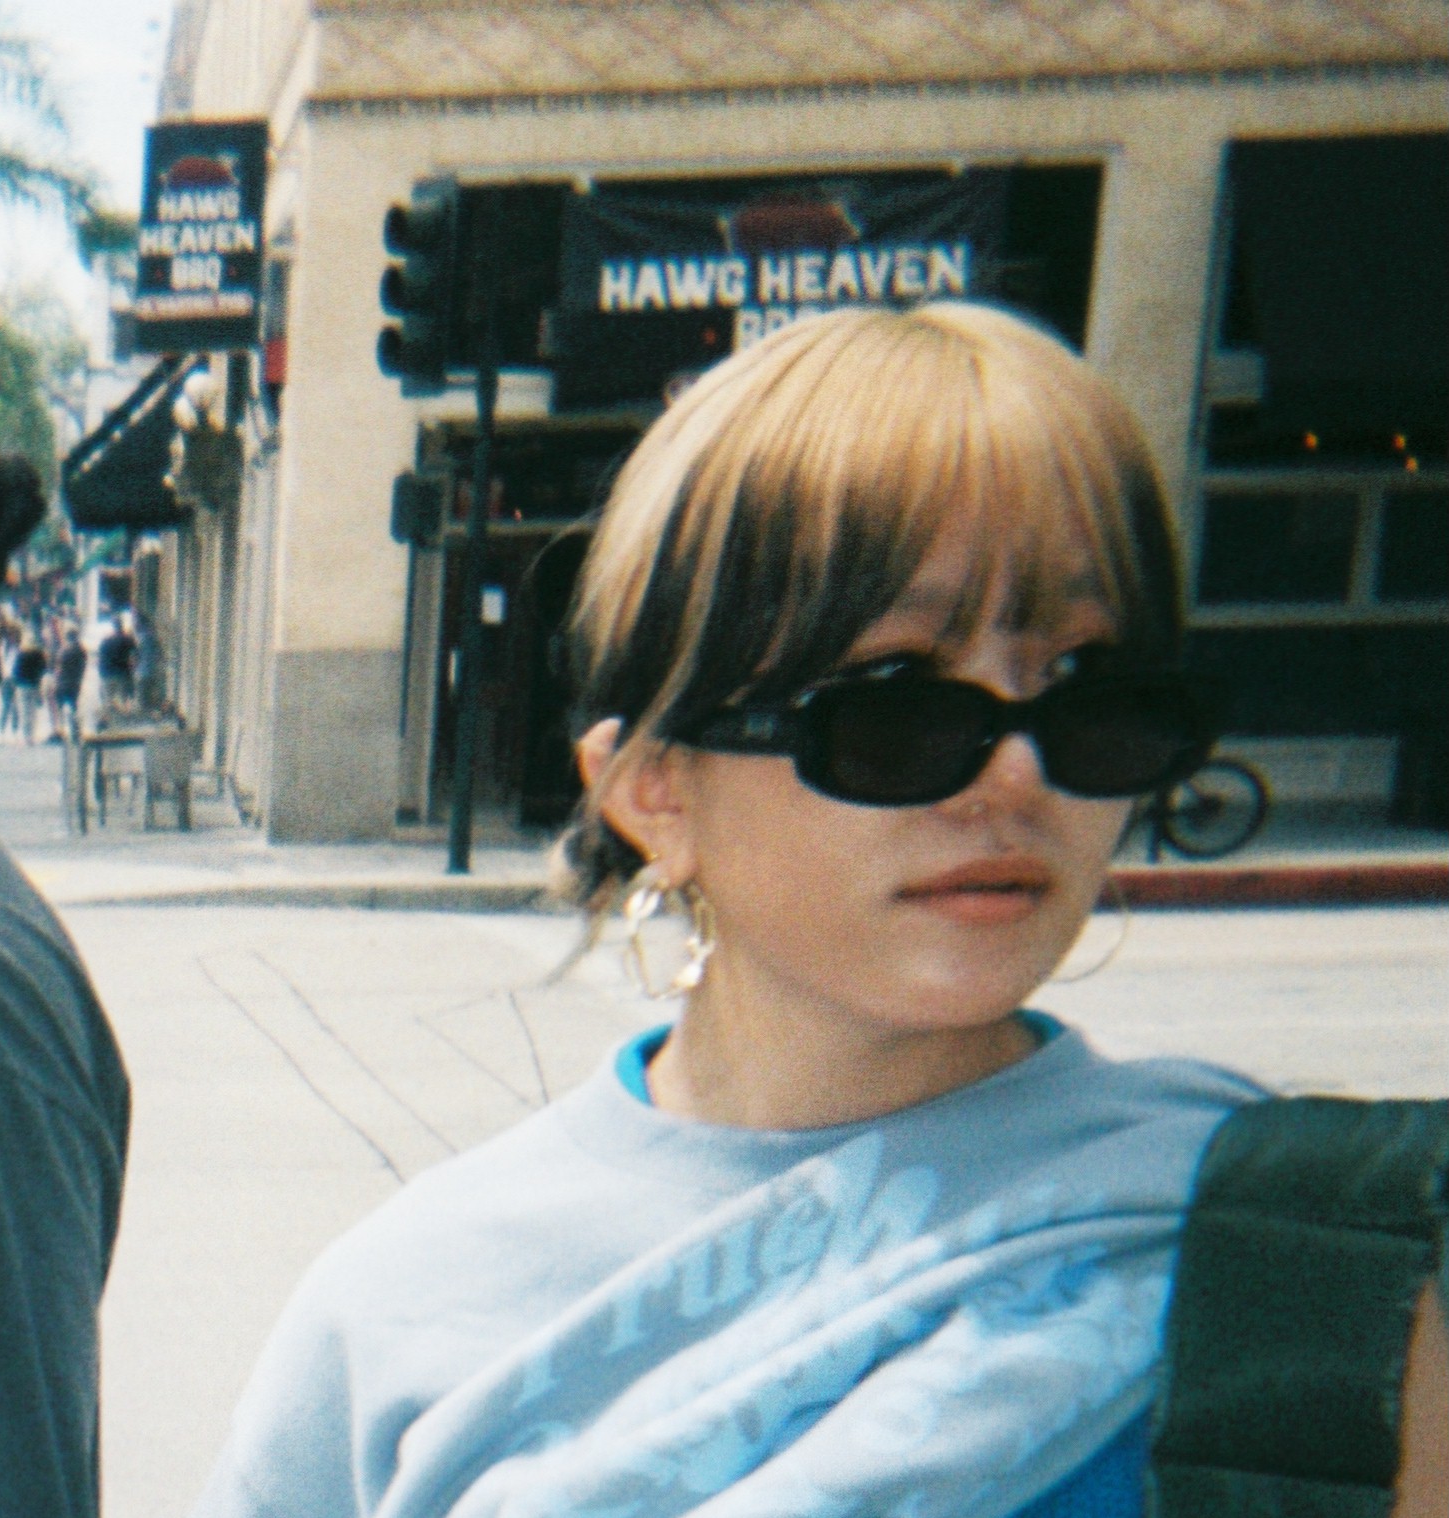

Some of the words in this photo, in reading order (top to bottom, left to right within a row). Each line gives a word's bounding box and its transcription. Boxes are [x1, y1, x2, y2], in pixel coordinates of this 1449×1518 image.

[139, 222, 255, 255] HEAVEN
[171, 254, 222, 291] BBQ
[599, 256, 749, 312] HAWG
[756, 243, 970, 301] HEAVEN
